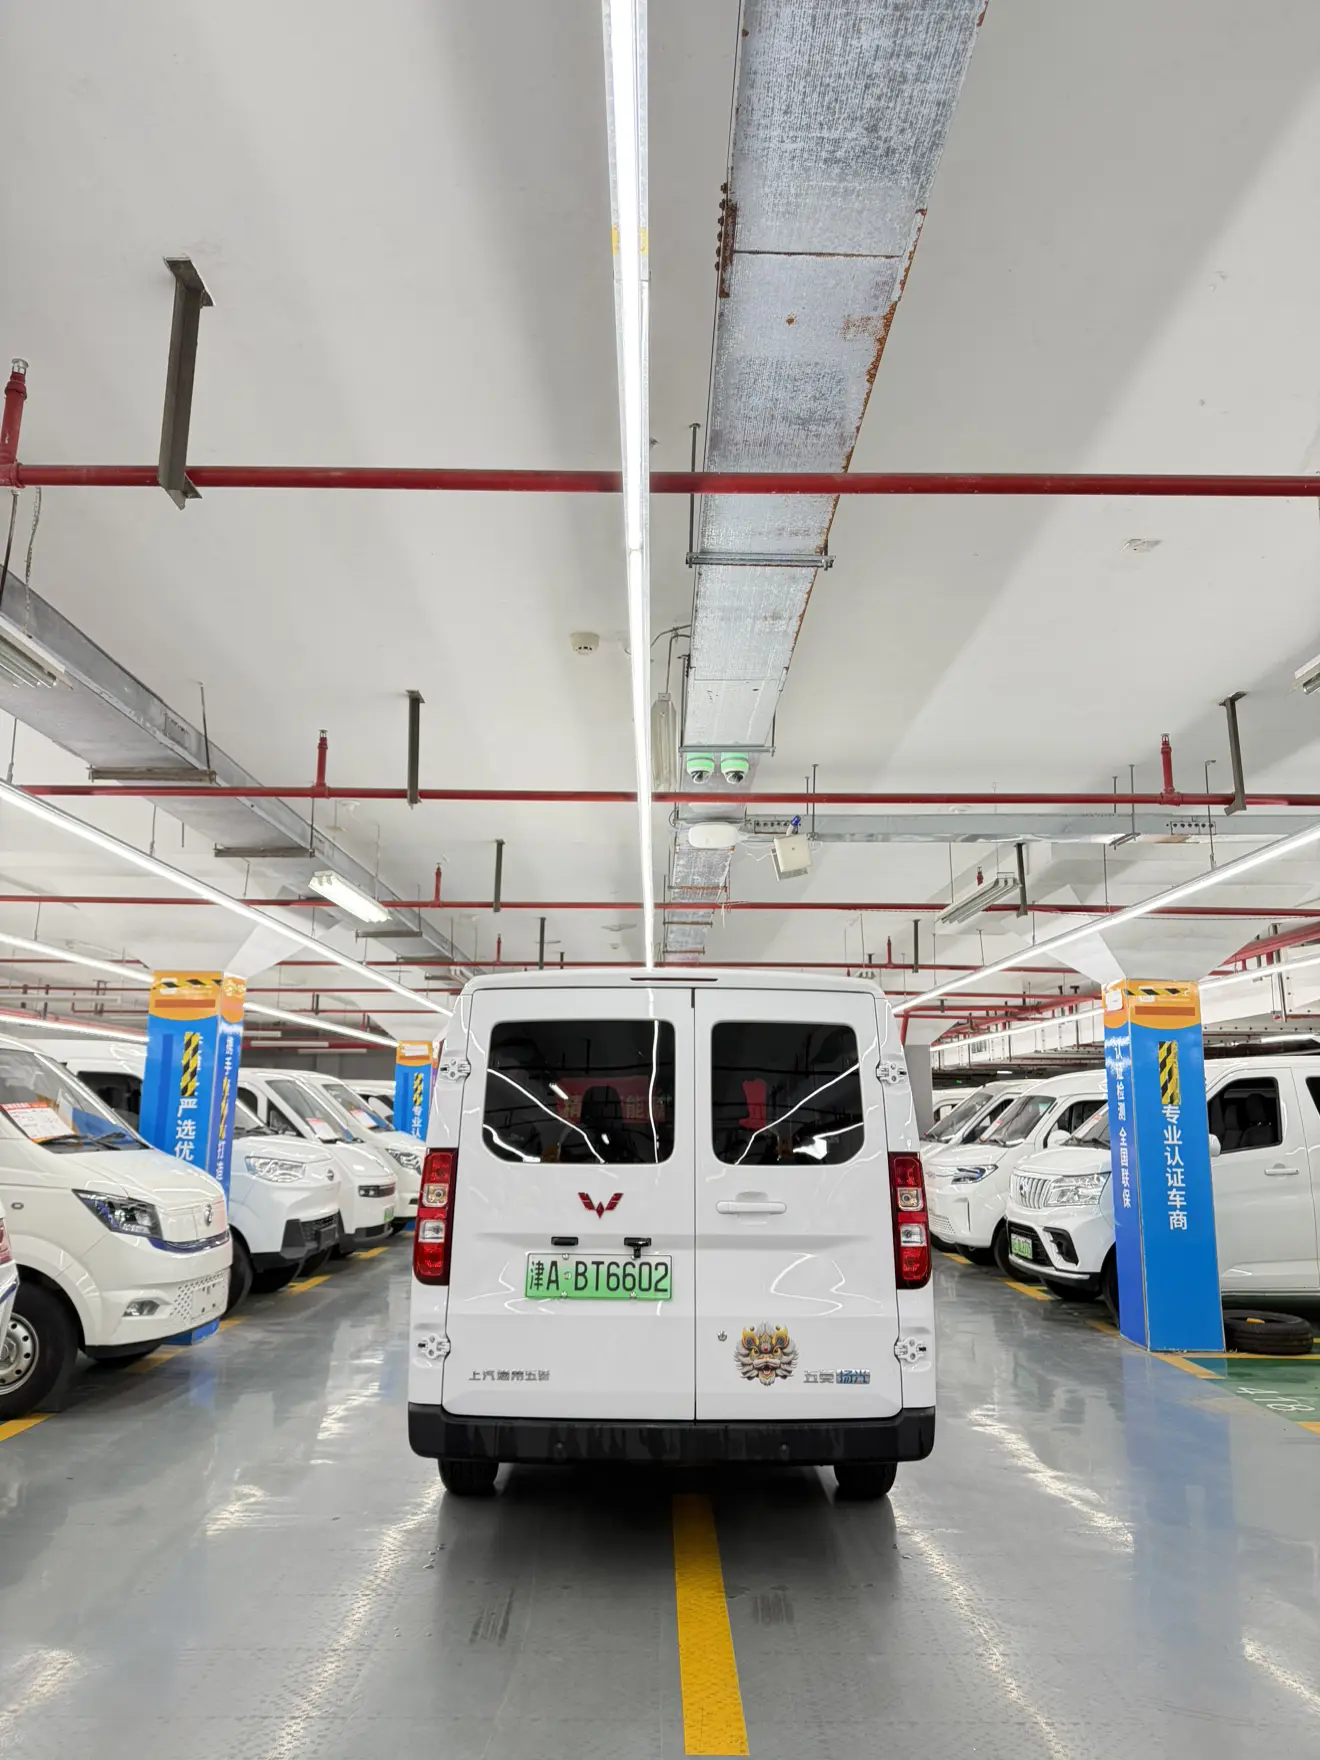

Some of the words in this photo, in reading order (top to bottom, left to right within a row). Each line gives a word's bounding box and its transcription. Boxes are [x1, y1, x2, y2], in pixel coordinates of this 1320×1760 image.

[1161, 1104, 1188, 1231] 专业认证车商
